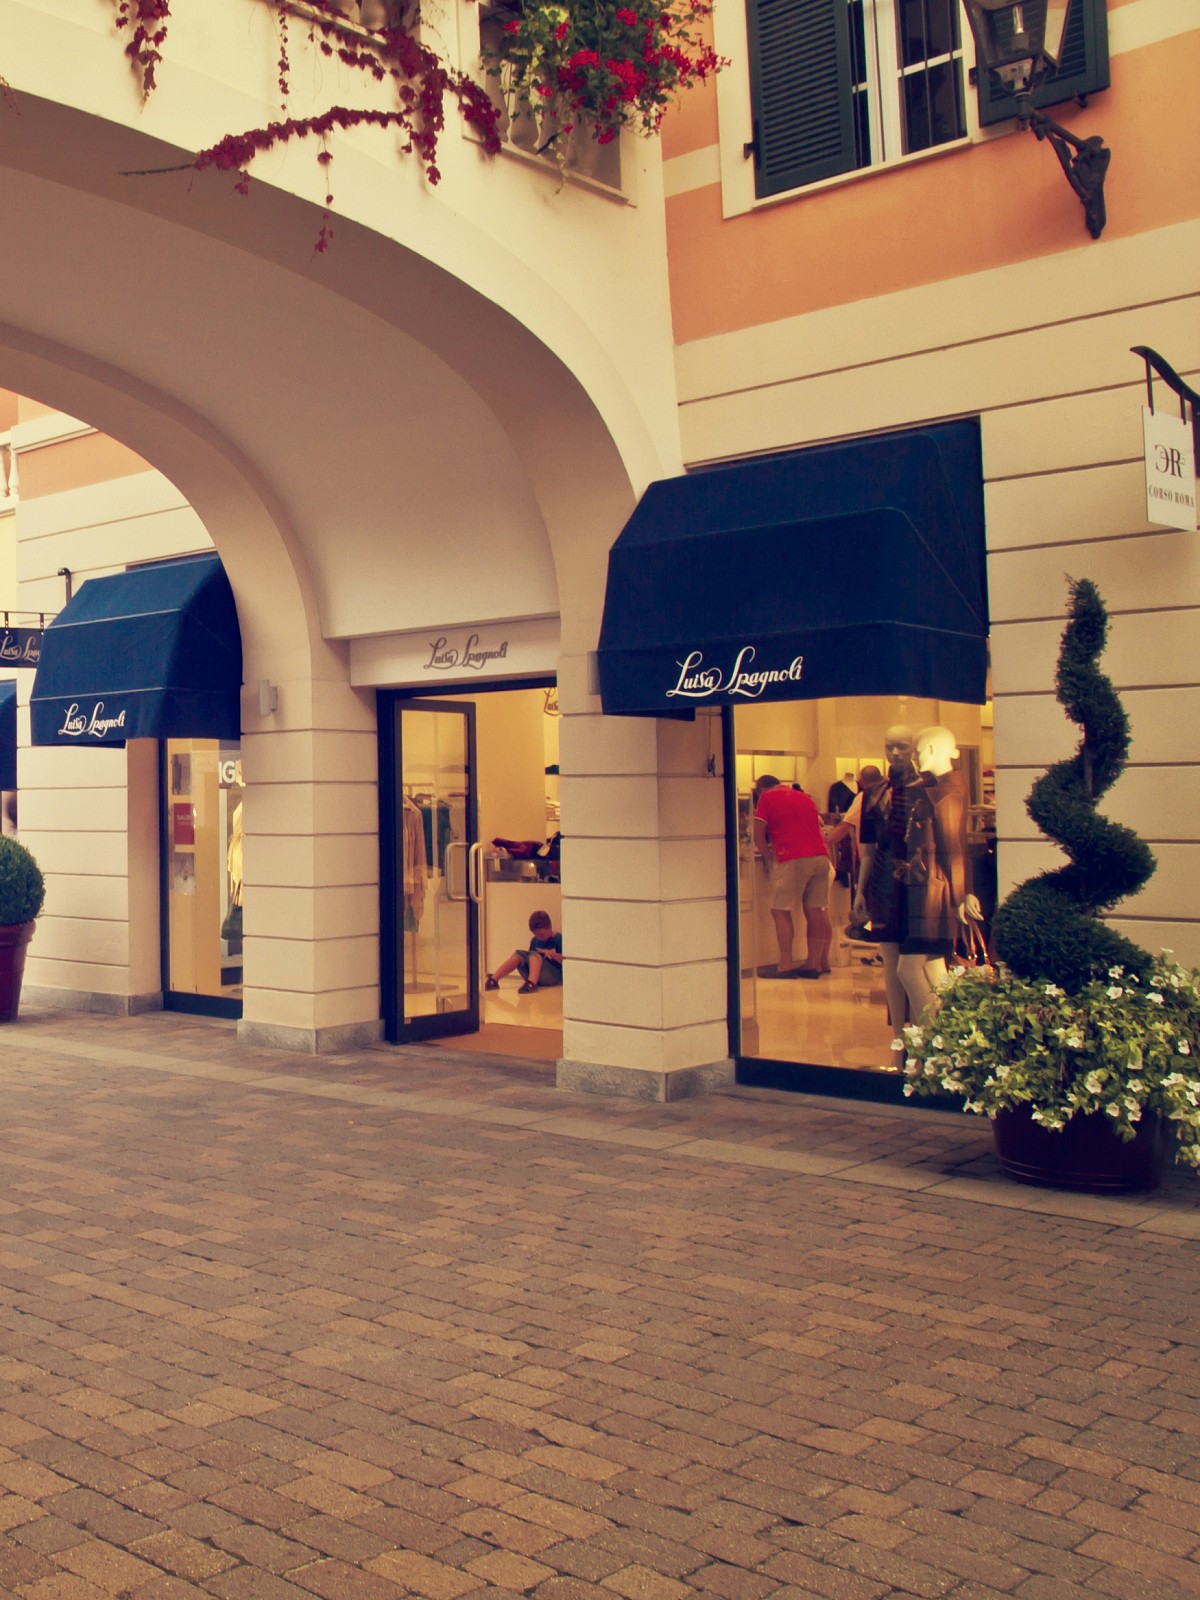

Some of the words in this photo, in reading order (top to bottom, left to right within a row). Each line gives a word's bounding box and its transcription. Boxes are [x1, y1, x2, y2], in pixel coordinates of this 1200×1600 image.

[1149, 485, 1173, 501] CORSO
[1175, 493, 1195, 507] ROMA
[423, 637, 459, 670] Luisa
[460, 634, 509, 670] Spagnoli
[666, 651, 722, 697] Luisa
[721, 646, 804, 697] Spagnoli
[58, 703, 87, 736] Luisa
[87, 702, 126, 737] Spagnoli
